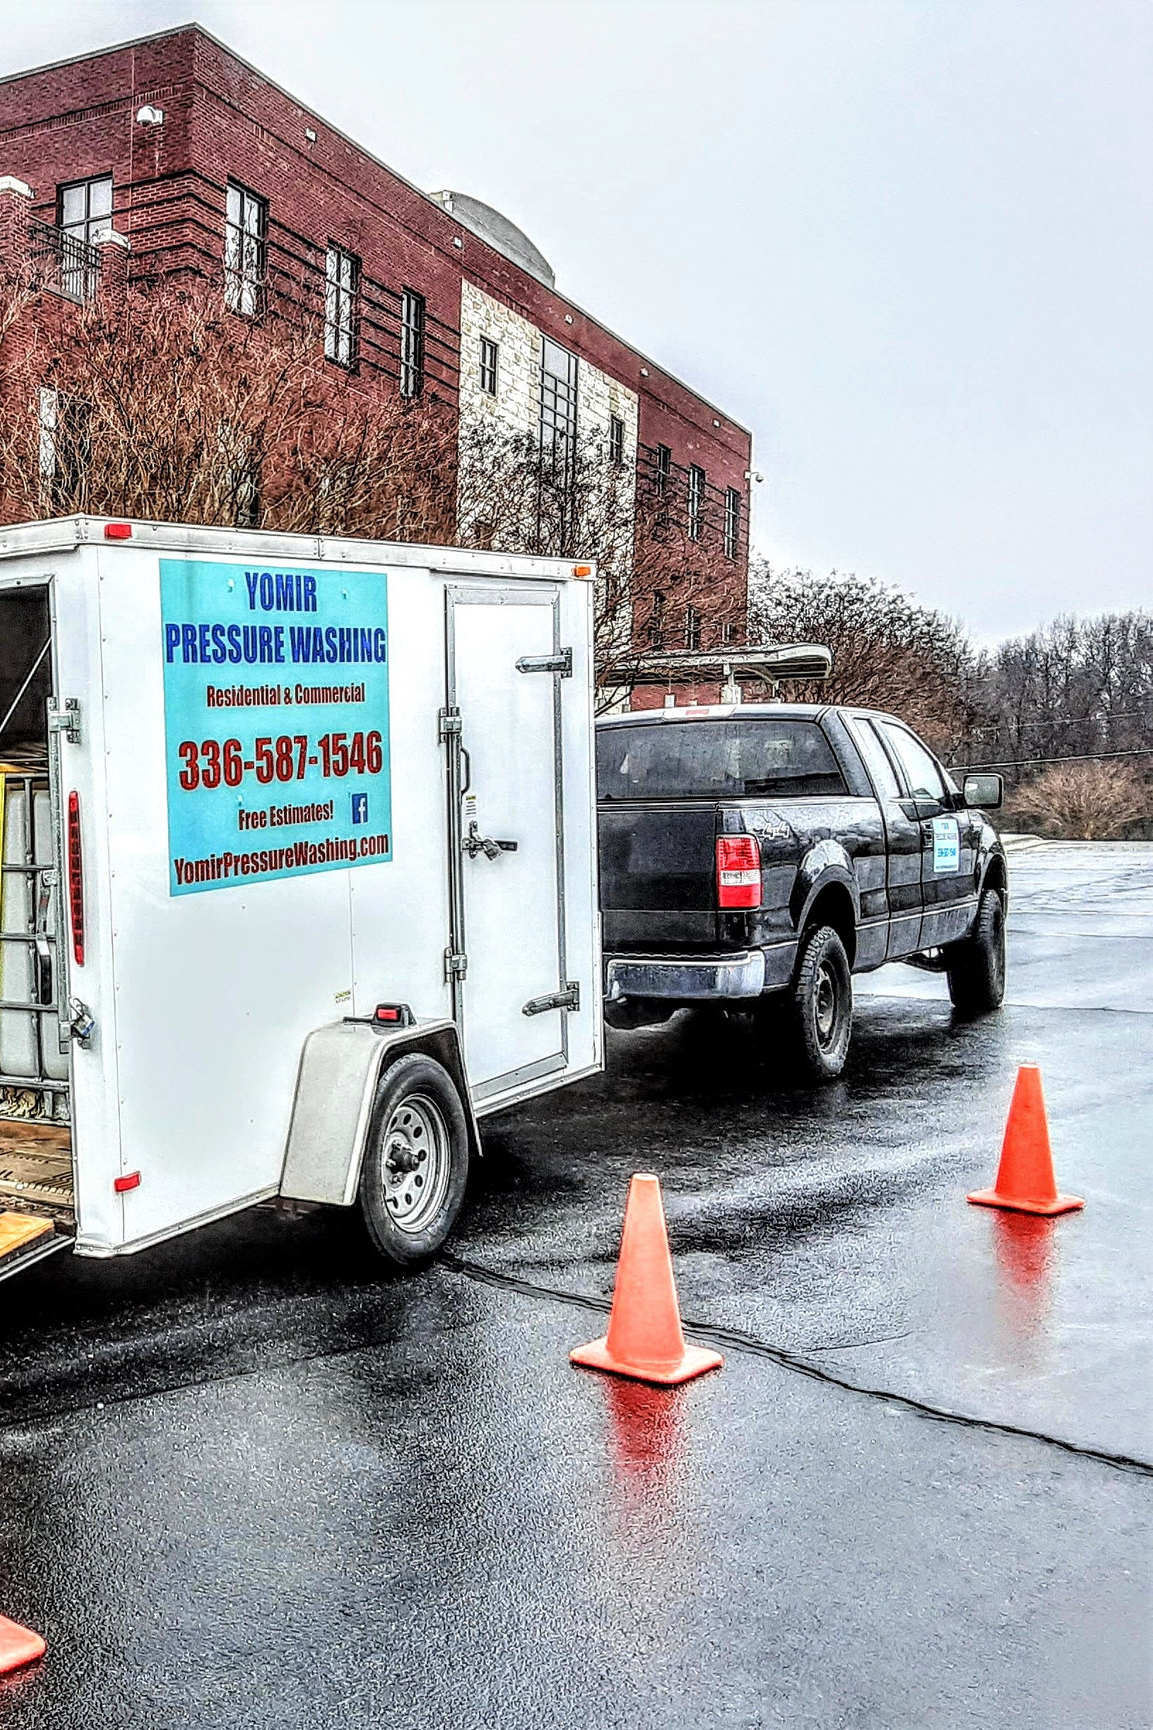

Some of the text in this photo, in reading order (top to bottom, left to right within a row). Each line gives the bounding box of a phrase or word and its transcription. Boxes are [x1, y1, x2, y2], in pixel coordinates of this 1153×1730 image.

[244, 572, 318, 612] YOMIR
[165, 623, 387, 663] PRESSURE WASHING
[206, 682, 366, 707] Residential & Commercial
[178, 730, 383, 791] 336-587-1546
[238, 800, 334, 831] Free Estimates!
[174, 834, 389, 886] YomirPressureWashing.com
